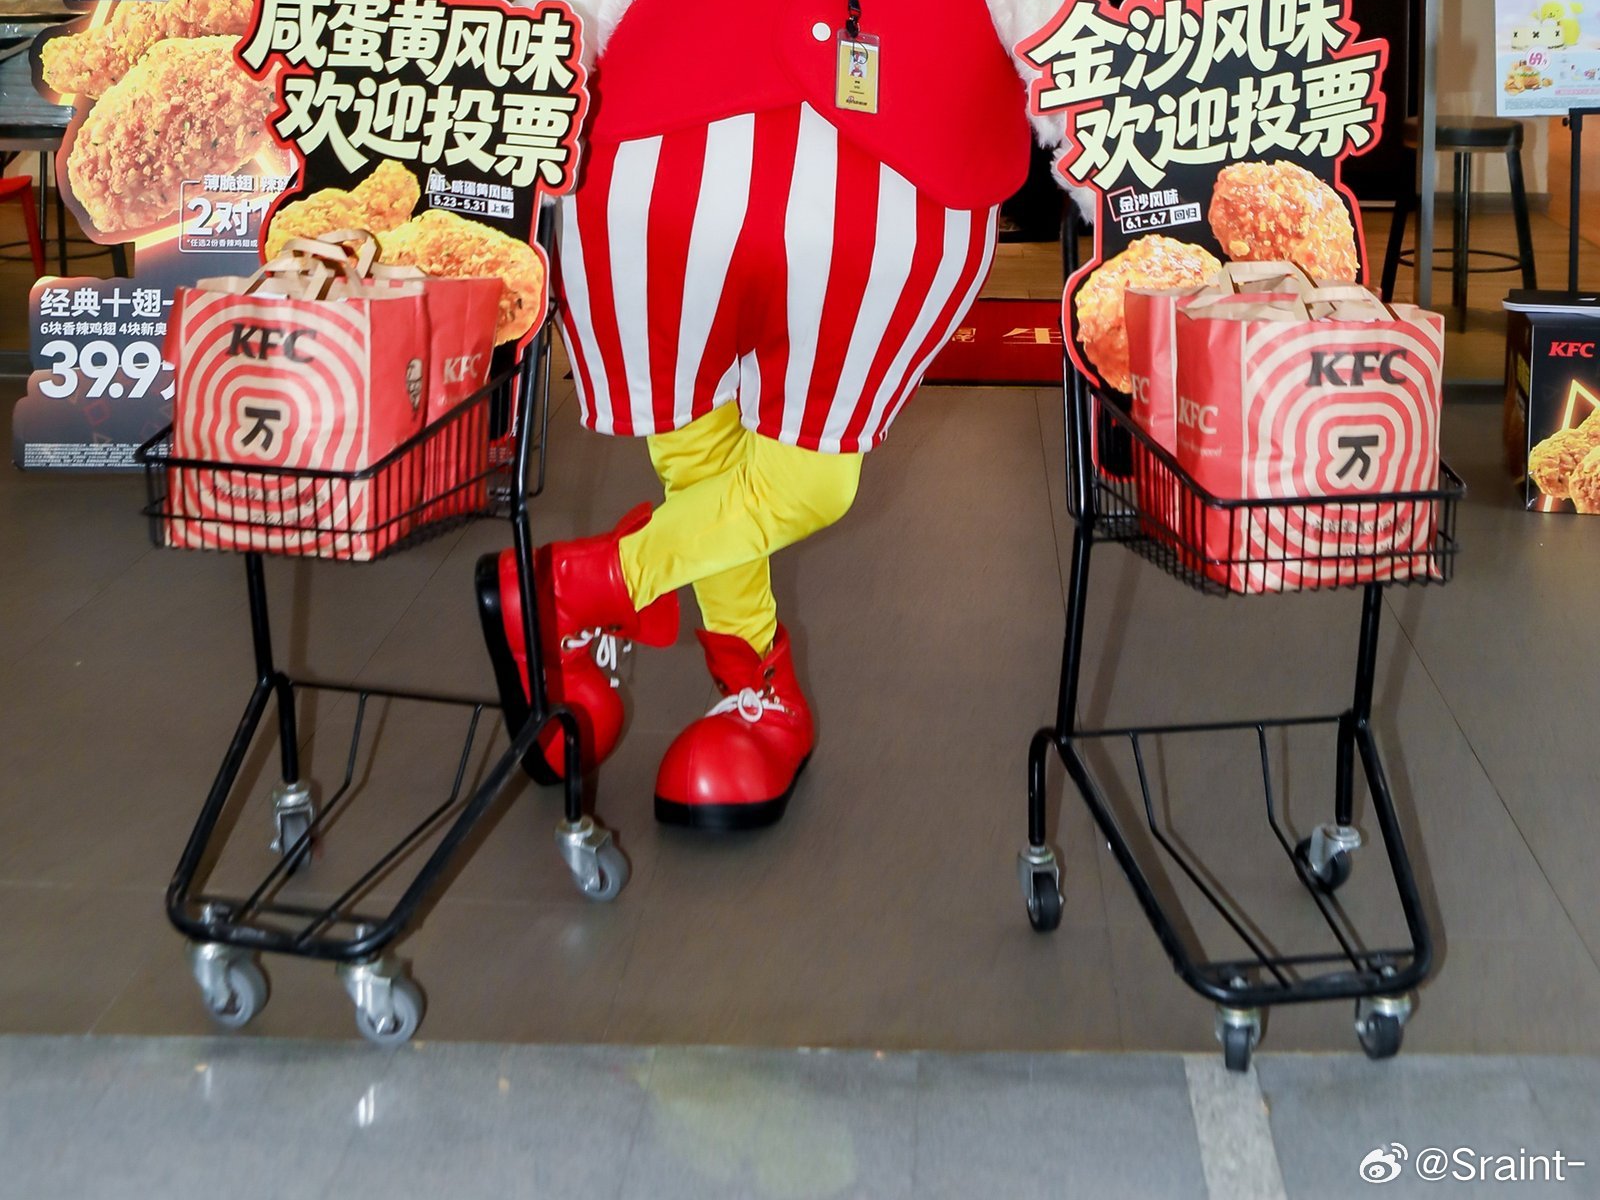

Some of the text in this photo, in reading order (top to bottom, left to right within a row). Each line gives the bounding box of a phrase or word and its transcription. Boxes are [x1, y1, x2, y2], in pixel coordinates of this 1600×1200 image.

[275, 71, 578, 188] 欢迎投票
[1068, 54, 1377, 191] 欢迎投票
[433, 195, 511, 214] 5.23-5.31 上新
[1119, 188, 1180, 213] 金沙风味
[1125, 207, 1197, 230] 6.1-6.7 回归
[40, 321, 117, 336] 6块香辣鸡翅
[225, 323, 318, 364] KFC
[1549, 341, 1595, 358] KFC
[443, 352, 482, 385] KFC
[1306, 348, 1408, 387] KFC
[1131, 374, 1150, 404] FC
[1178, 396, 1219, 435] KFC
